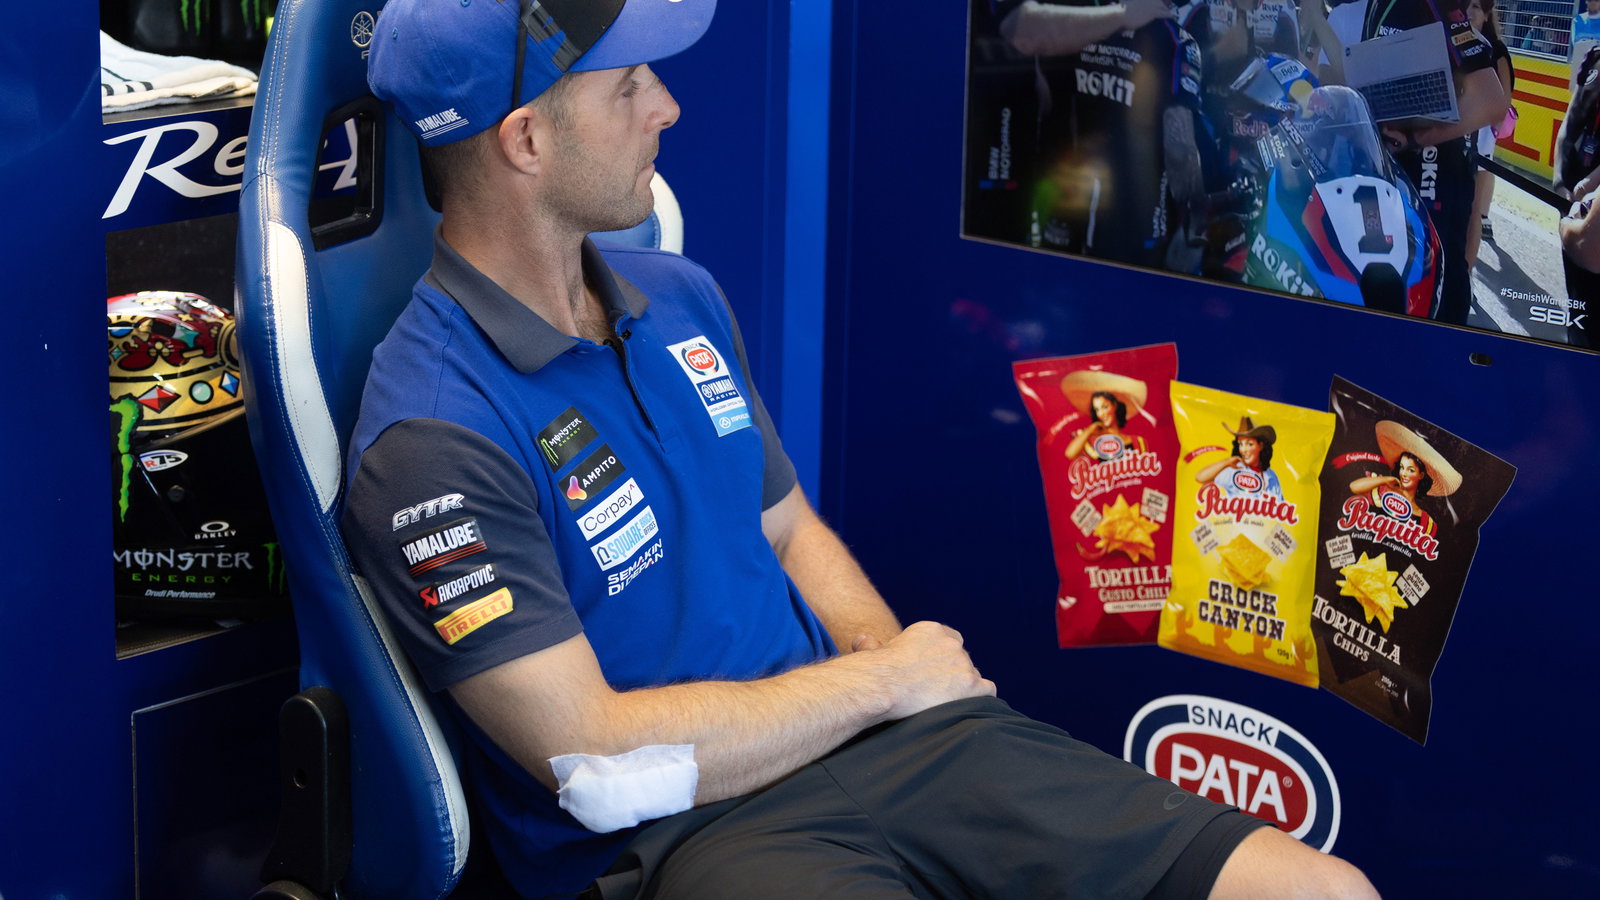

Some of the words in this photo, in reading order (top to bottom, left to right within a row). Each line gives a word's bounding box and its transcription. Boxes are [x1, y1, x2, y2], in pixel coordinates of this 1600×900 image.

[415, 108, 462, 132] YAMALUBE
[1353, 185, 1394, 254] 1
[1529, 305, 1586, 330] SBK
[688, 351, 713, 367] PATA
[548, 418, 582, 447] MONSTER
[582, 456, 616, 489] AMPITO
[1069, 450, 1162, 498] Paquita
[1238, 475, 1257, 489] PATA
[392, 493, 465, 532] GYTR
[583, 489, 633, 533] Corpay
[1196, 482, 1297, 525] Paquita
[1387, 498, 1405, 514] PATA
[195, 529, 237, 540] OAKLEY
[402, 521, 478, 566] YAMALUBE
[607, 522, 645, 560] SQUARE
[1338, 496, 1439, 560] Paquita
[113, 548, 254, 571] MONSTER
[132, 573, 232, 583] ENERGY
[607, 538, 662, 586] SEMAKIN
[608, 581, 625, 597] DI
[625, 548, 664, 587] DEPAN
[145, 589, 166, 598] Drudi
[166, 589, 216, 599] Performance
[1208, 579, 1277, 616] CROCK
[437, 593, 508, 641] PIRELLI
[1198, 600, 1285, 641] CANYON
[1312, 594, 1401, 666] TORTILLA
[1332, 632, 1370, 662] CHIPS
[1192, 705, 1275, 746] SNACK
[1170, 742, 1288, 823] PATA
